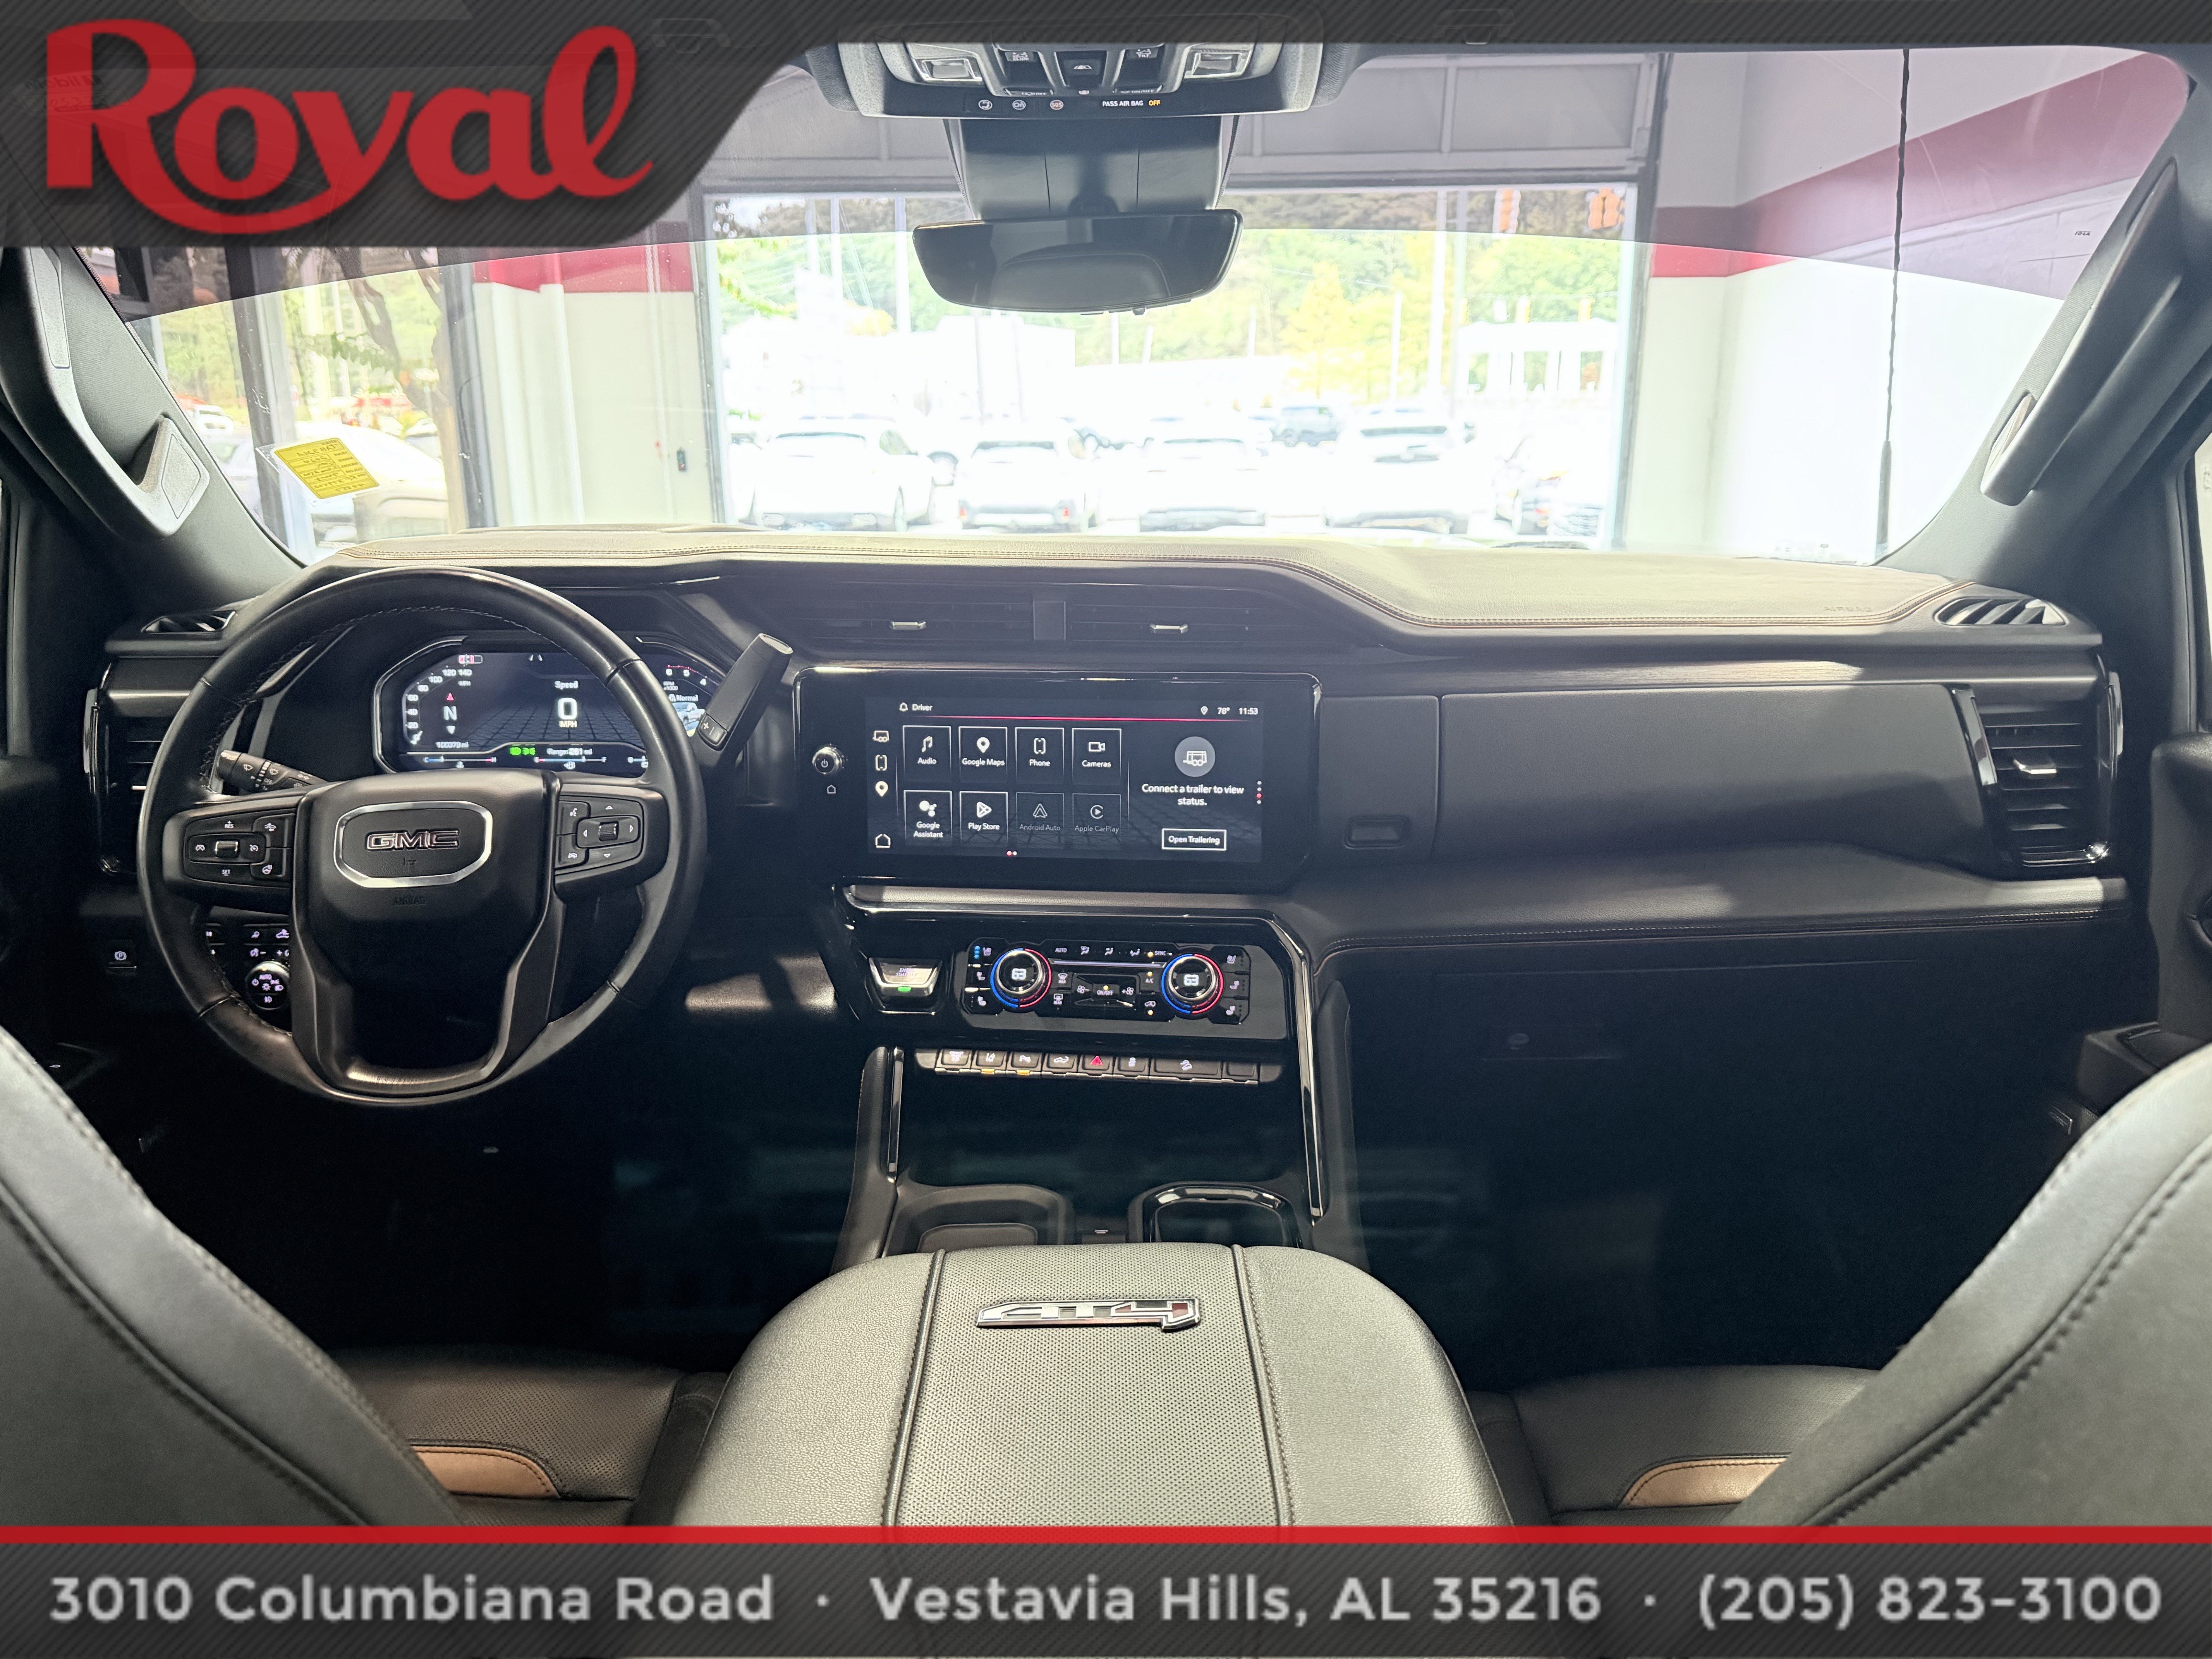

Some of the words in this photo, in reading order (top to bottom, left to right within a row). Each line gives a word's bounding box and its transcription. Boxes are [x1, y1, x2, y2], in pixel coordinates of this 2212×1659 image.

[554, 680, 579, 690] Speed
[443, 706, 457, 720] N
[558, 697, 577, 720] 0
[962, 758, 985, 766] Google
[986, 759, 1005, 767] Maps
[1142, 784, 1178, 793] Connect
[1186, 784, 1212, 794] trailer
[1224, 785, 1244, 794] view
[1178, 797, 1207, 805] status.
[916, 822, 940, 830] Google
[1075, 825, 1093, 833] Apple
[1094, 825, 1119, 834] CarPlay
[367, 830, 460, 851] GMC
[1168, 836, 1187, 844] Open
[1188, 836, 1220, 845] Trailering
[976, 1298, 1201, 1333] AT4
